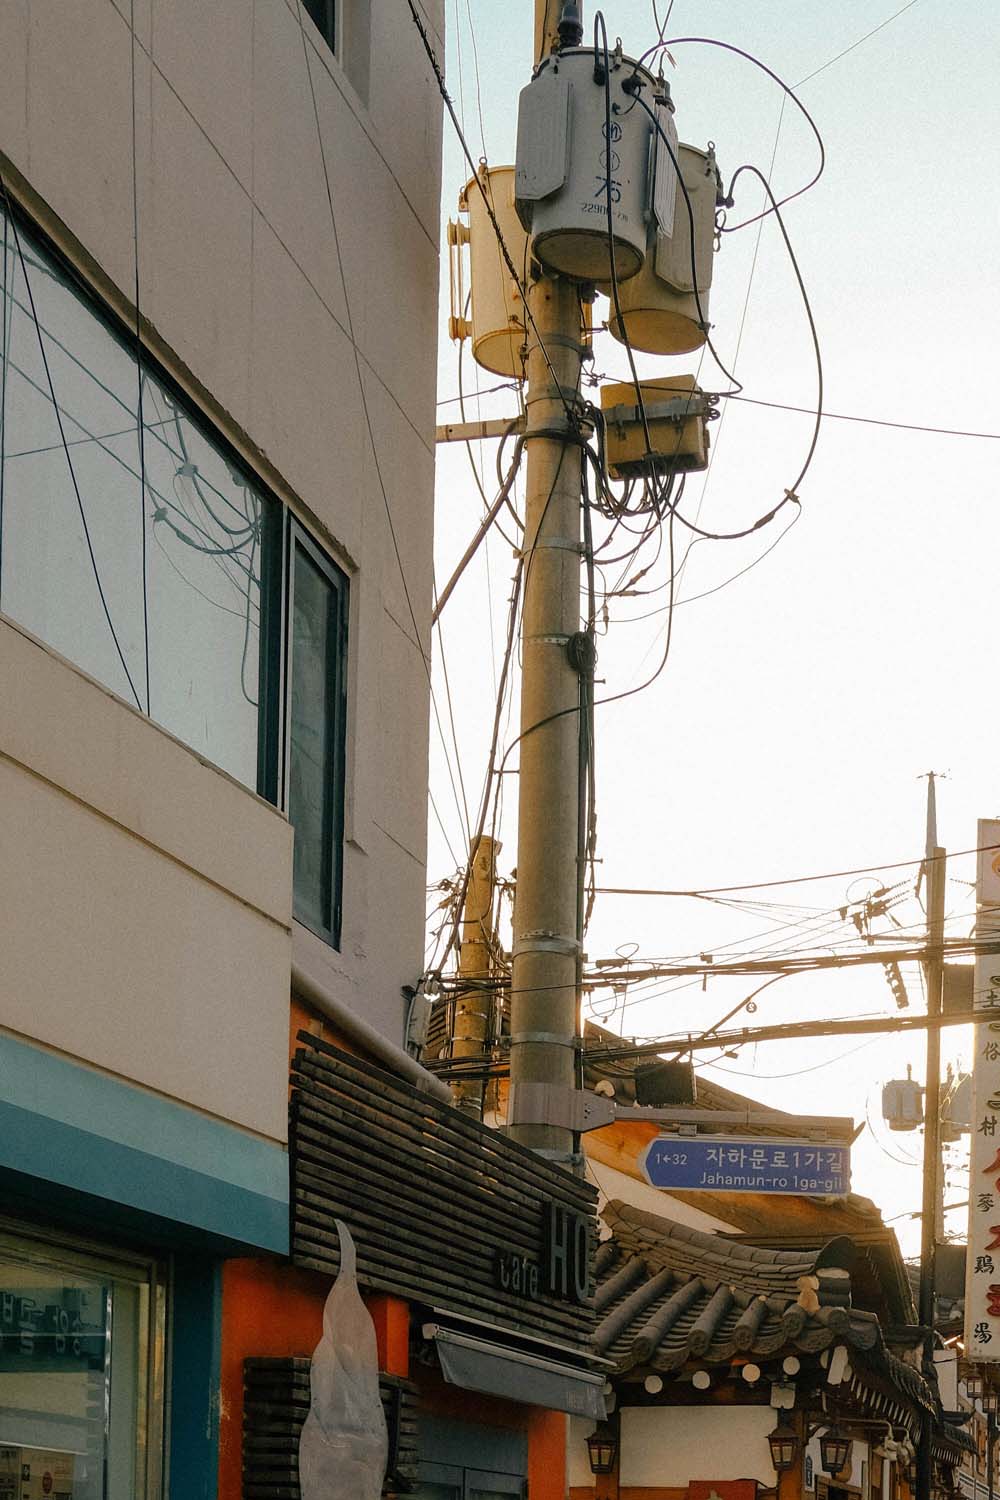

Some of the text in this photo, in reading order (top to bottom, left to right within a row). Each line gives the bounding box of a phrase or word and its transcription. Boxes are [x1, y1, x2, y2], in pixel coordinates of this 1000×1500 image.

[705, 1147, 843, 1172] 자하문로1가길
[700, 1171, 842, 1193] Jahamun-ro 1ga-gil
